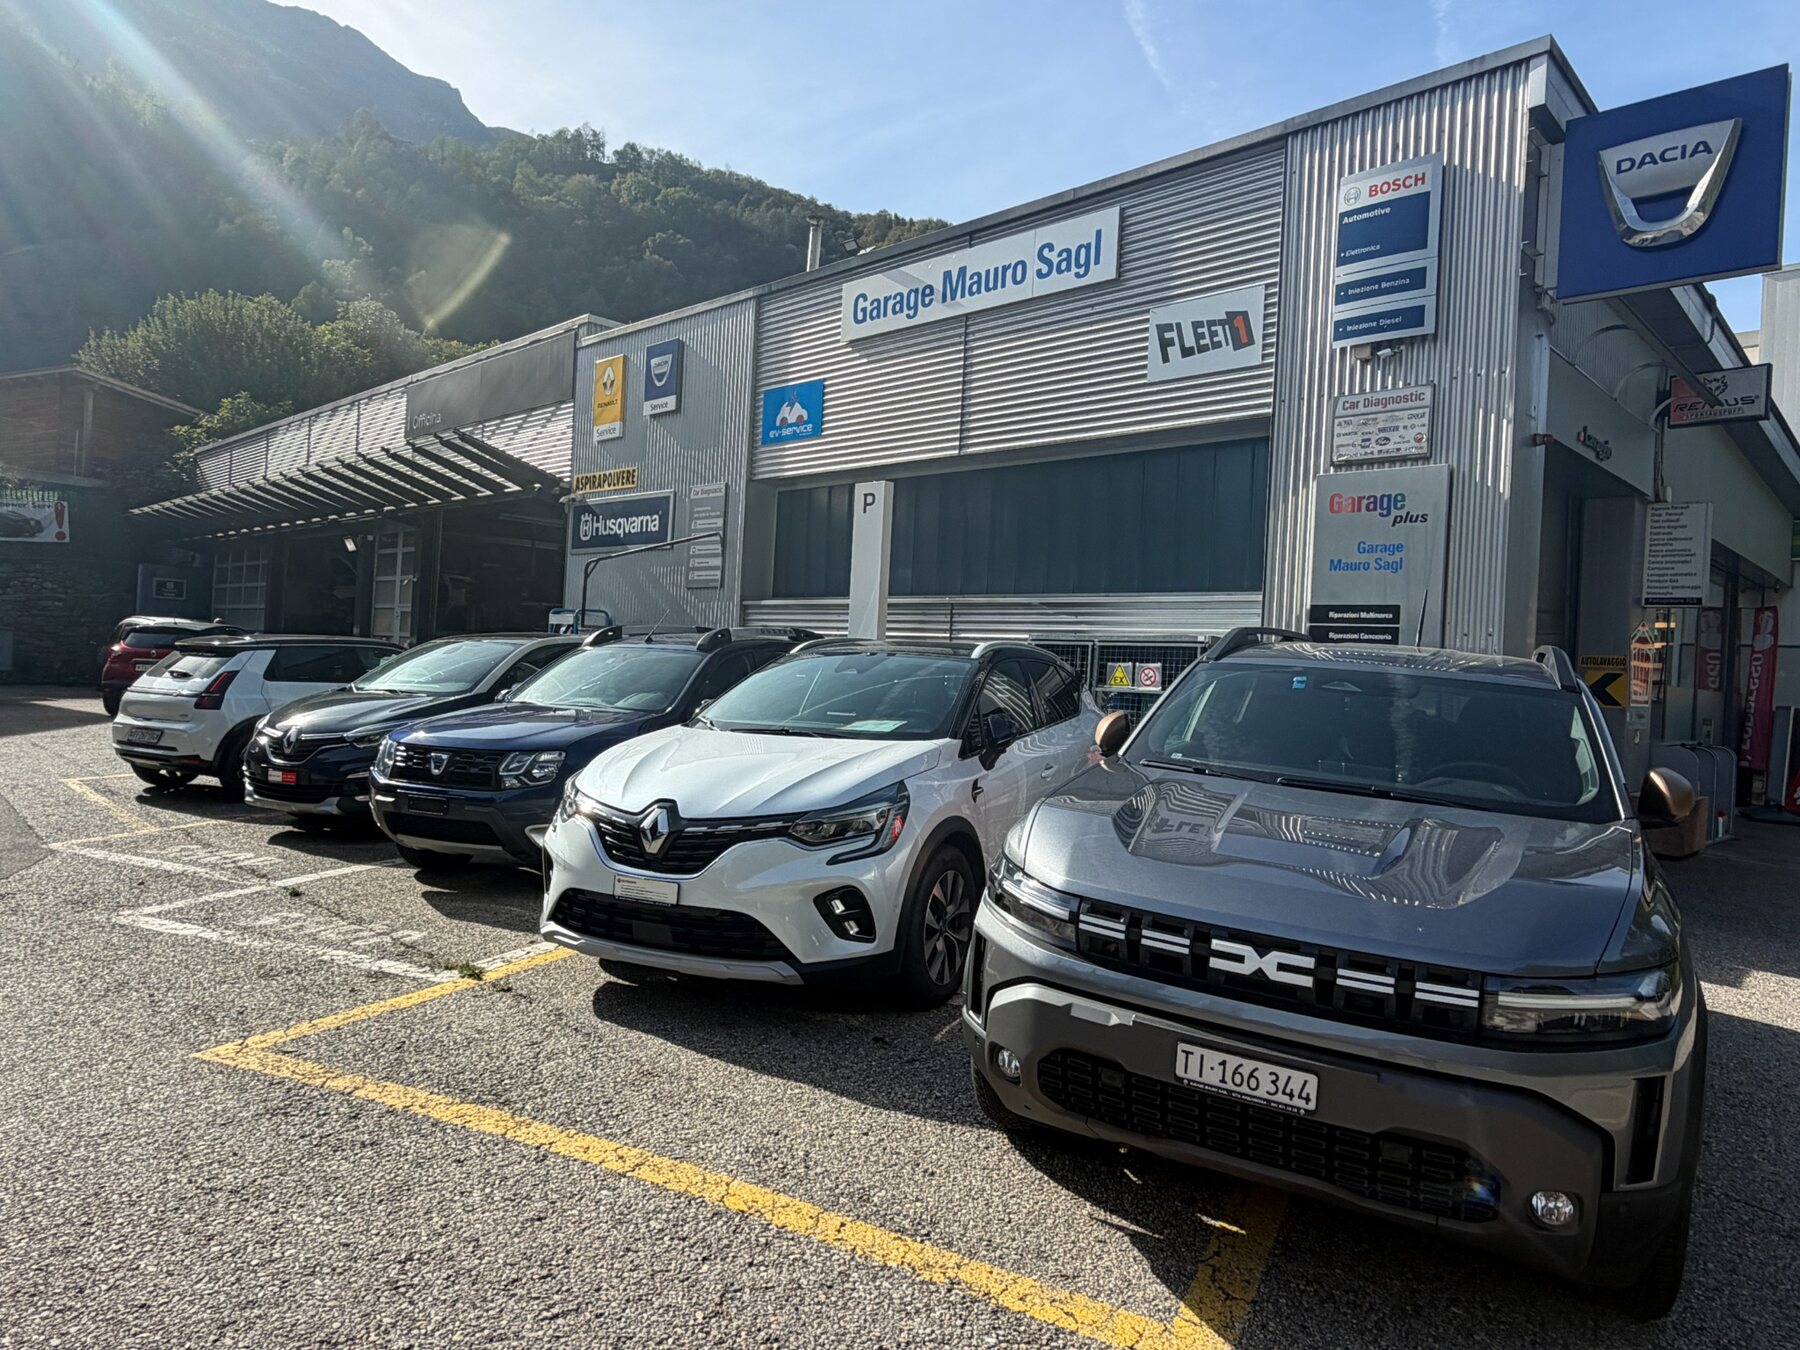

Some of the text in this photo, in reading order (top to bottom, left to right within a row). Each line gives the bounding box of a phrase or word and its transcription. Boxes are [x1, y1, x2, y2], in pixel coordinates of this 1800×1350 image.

[1615, 140, 1713, 175] DACIA
[1368, 172, 1426, 198] BOSCH
[1342, 205, 1391, 225] Automotive
[1345, 243, 1381, 257] Elettronica
[852, 229, 1102, 325] Garage Mauro Sagl
[1347, 277, 1410, 295] Iniezione Benzina
[1346, 315, 1402, 332] Iniezione Diesel
[597, 398, 618, 409] RENAULT
[650, 400, 669, 412] Service
[1342, 391, 1425, 411] Car Diagnostic
[596, 426, 617, 438] Service
[769, 423, 813, 438] ev-service
[574, 468, 637, 491] ASPIRAPOLVERE
[863, 492, 876, 514] P
[1329, 492, 1406, 517] Garage
[592, 513, 660, 538] Husqvarna
[1391, 511, 1429, 527] plus
[1357, 541, 1404, 557] Garage
[1329, 557, 1403, 573] Mauro Sagl
[1580, 656, 1627, 666] AUTOLAVAGGIO
[1113, 676, 1125, 684] EX
